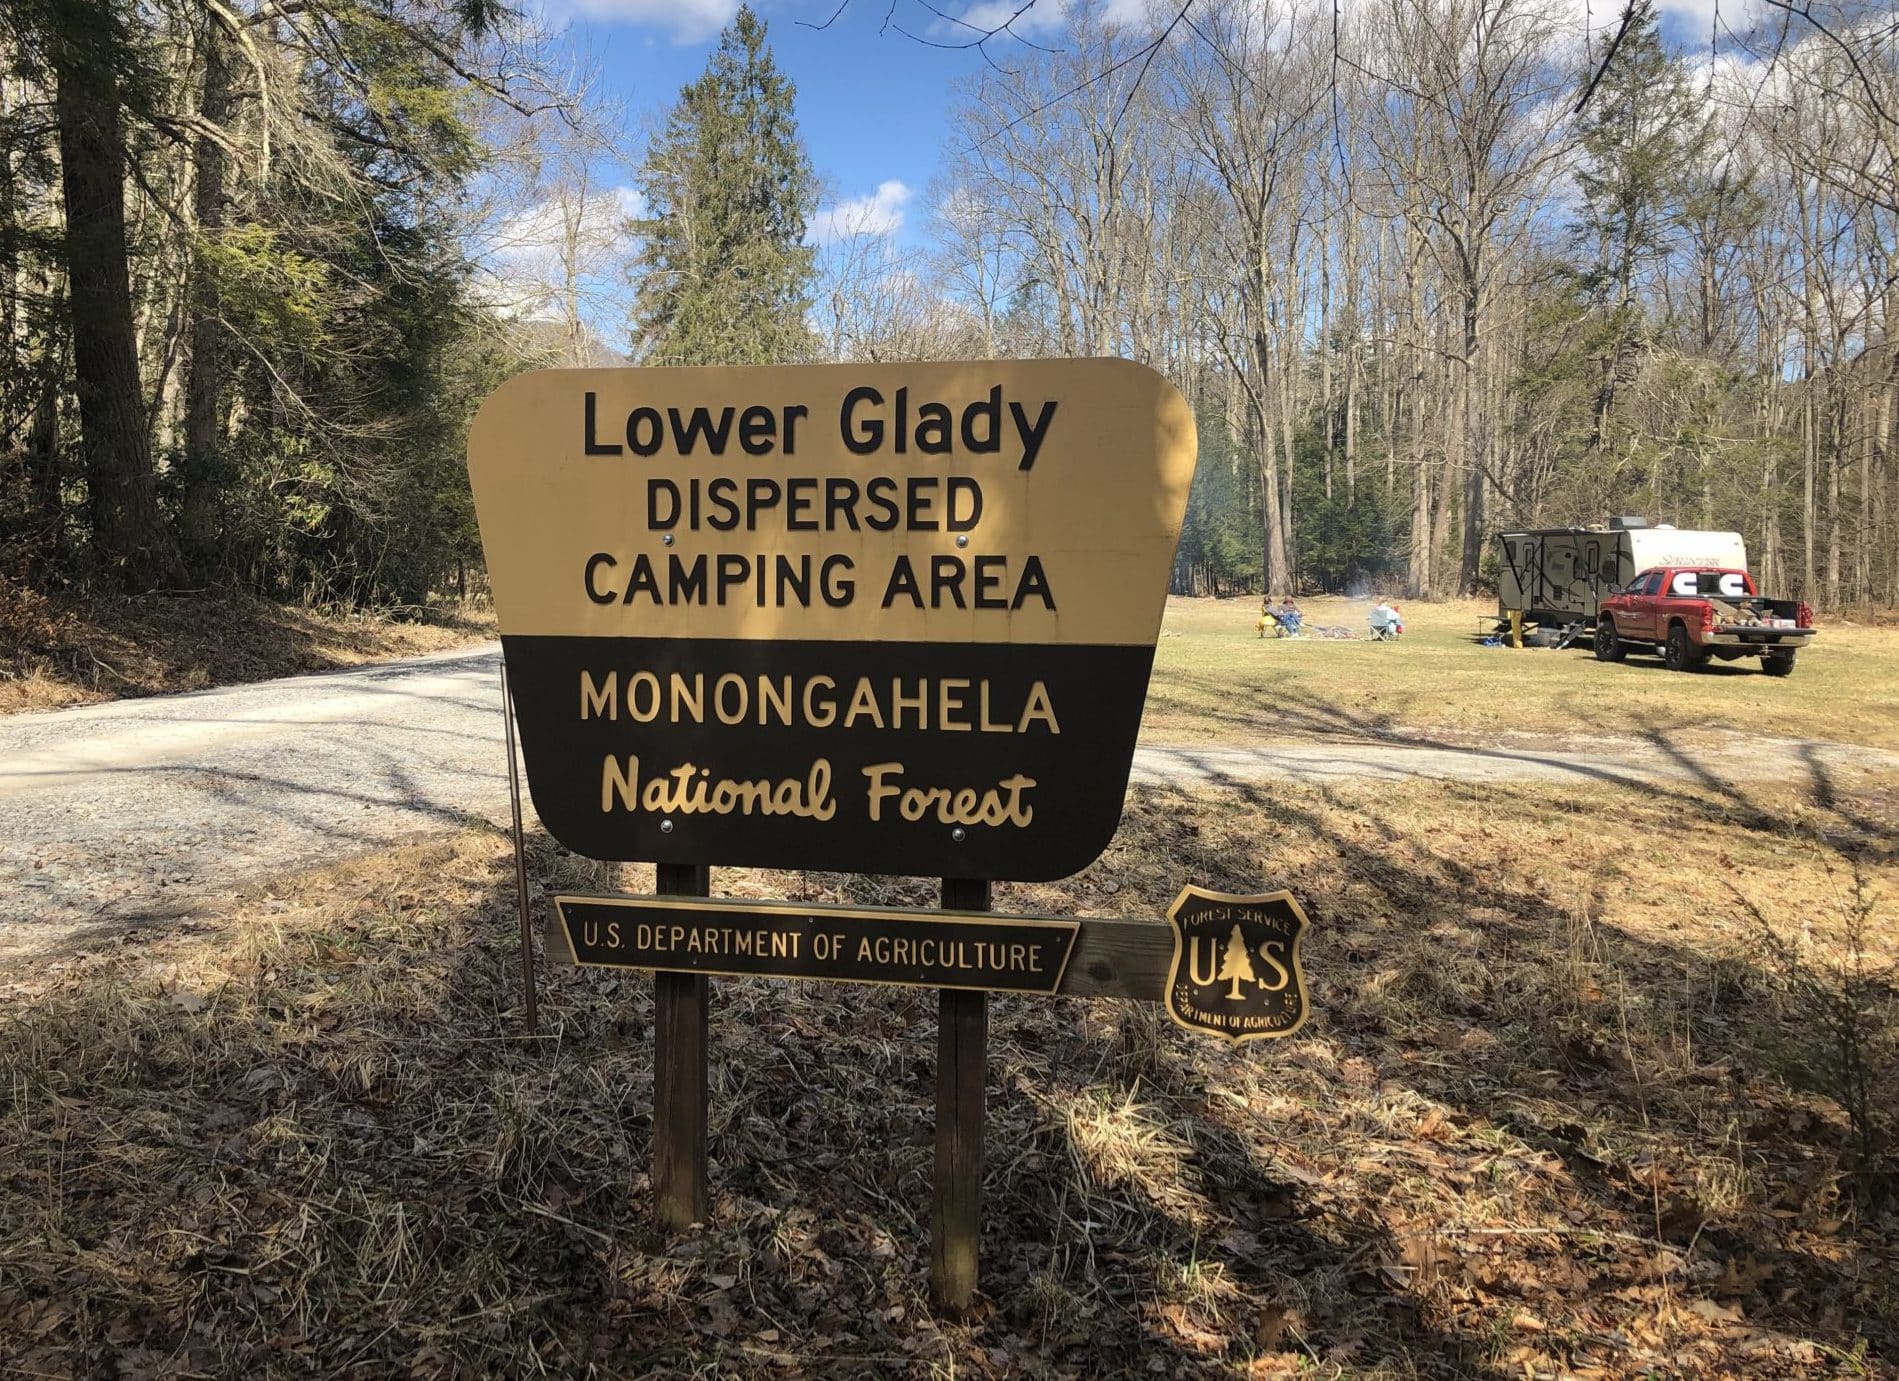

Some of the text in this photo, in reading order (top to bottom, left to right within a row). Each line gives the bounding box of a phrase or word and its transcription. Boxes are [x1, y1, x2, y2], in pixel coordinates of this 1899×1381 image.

[585, 384, 1058, 472] Lower Glady
[648, 477, 982, 531] DISPERSED
[585, 553, 1057, 611] CAMPING AREA
[580, 670, 1061, 735] MONONGAHELA
[602, 754, 1037, 828] National Forest
[584, 922, 1043, 972] U.S. DEPARTMENT OF AGRICULTURE
[1184, 908, 1291, 936] FOREST SERVICE
